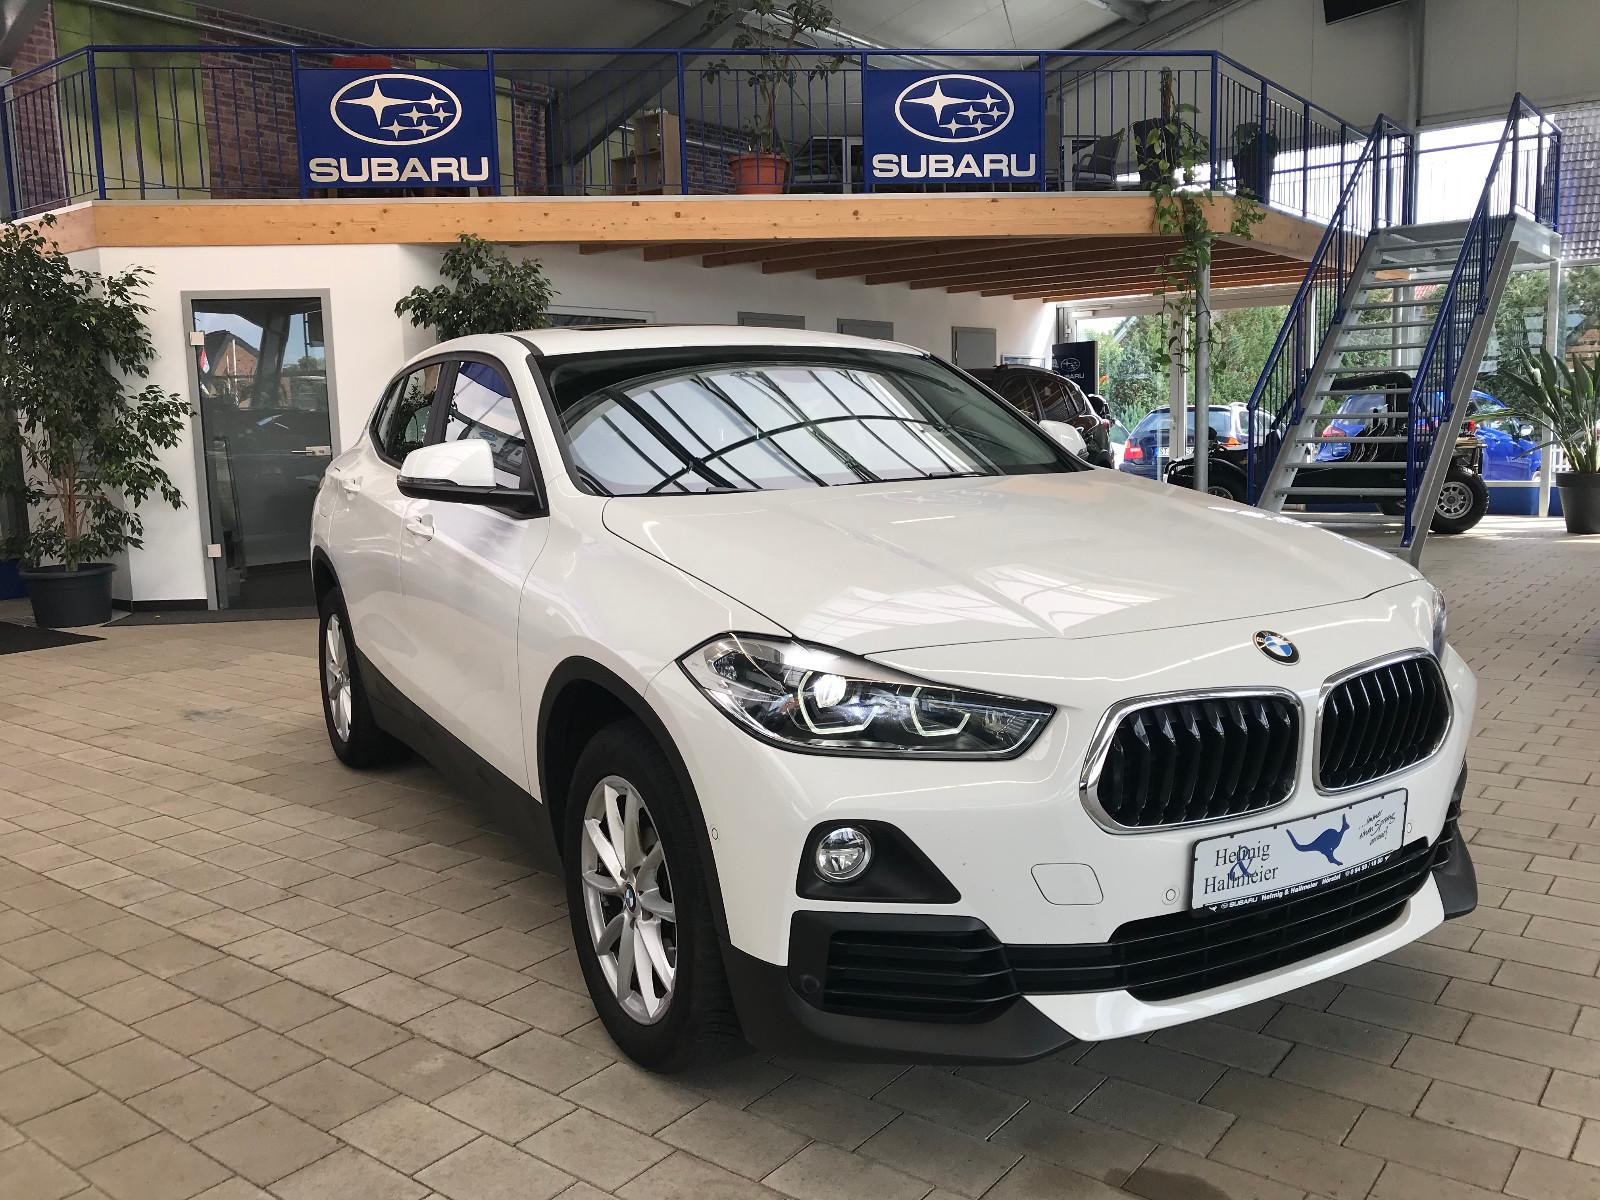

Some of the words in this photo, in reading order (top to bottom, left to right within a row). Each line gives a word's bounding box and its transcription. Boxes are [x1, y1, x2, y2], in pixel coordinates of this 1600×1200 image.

[308, 156, 489, 183] SUBARU
[872, 153, 1036, 178] SUBARU
[1215, 840, 1271, 867] Helmig
[1204, 865, 1279, 895] Hallmeier
[1229, 896, 1258, 908] SUBARU
